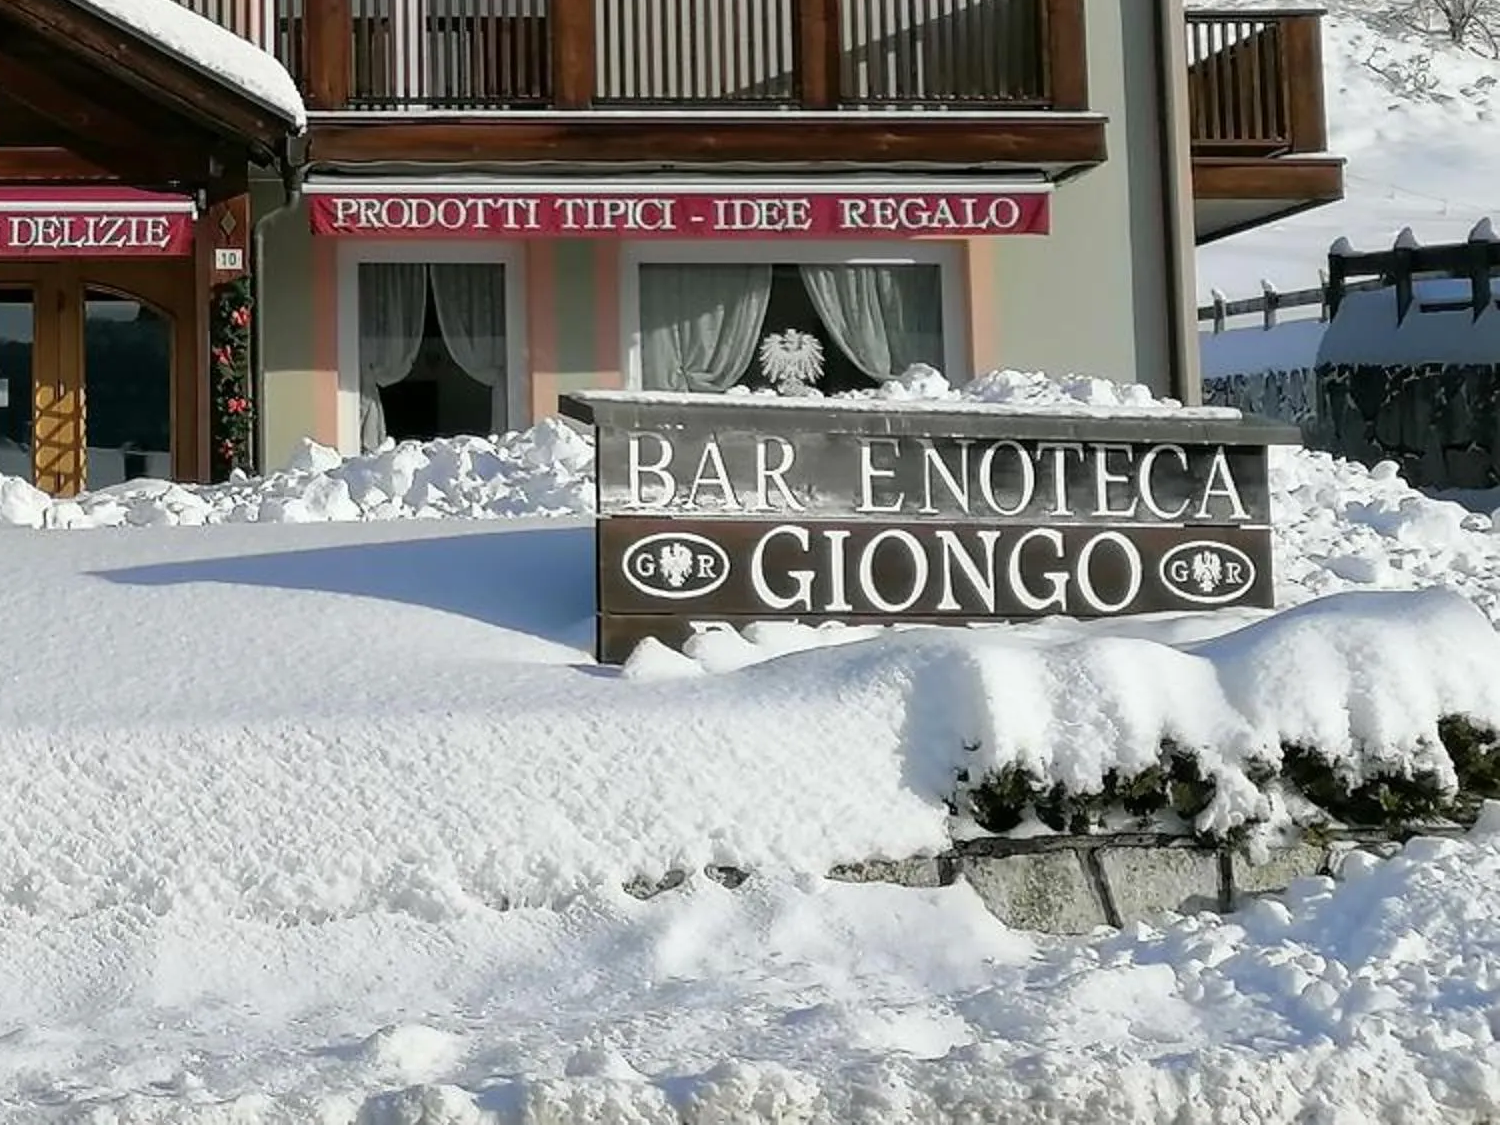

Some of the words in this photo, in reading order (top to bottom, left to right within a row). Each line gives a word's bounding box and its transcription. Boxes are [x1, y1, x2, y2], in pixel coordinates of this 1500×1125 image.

[332, 197, 541, 230] PRODOTTI
[553, 198, 677, 231] TIPICI
[713, 198, 813, 231] IDEE
[838, 197, 1021, 230] REGALO
[8, 215, 172, 249] DELIZIE
[221, 252, 237, 266] 10
[624, 430, 806, 512] BAR
[855, 437, 1252, 520] ENOTECA
[750, 525, 1143, 614] GIONGO
